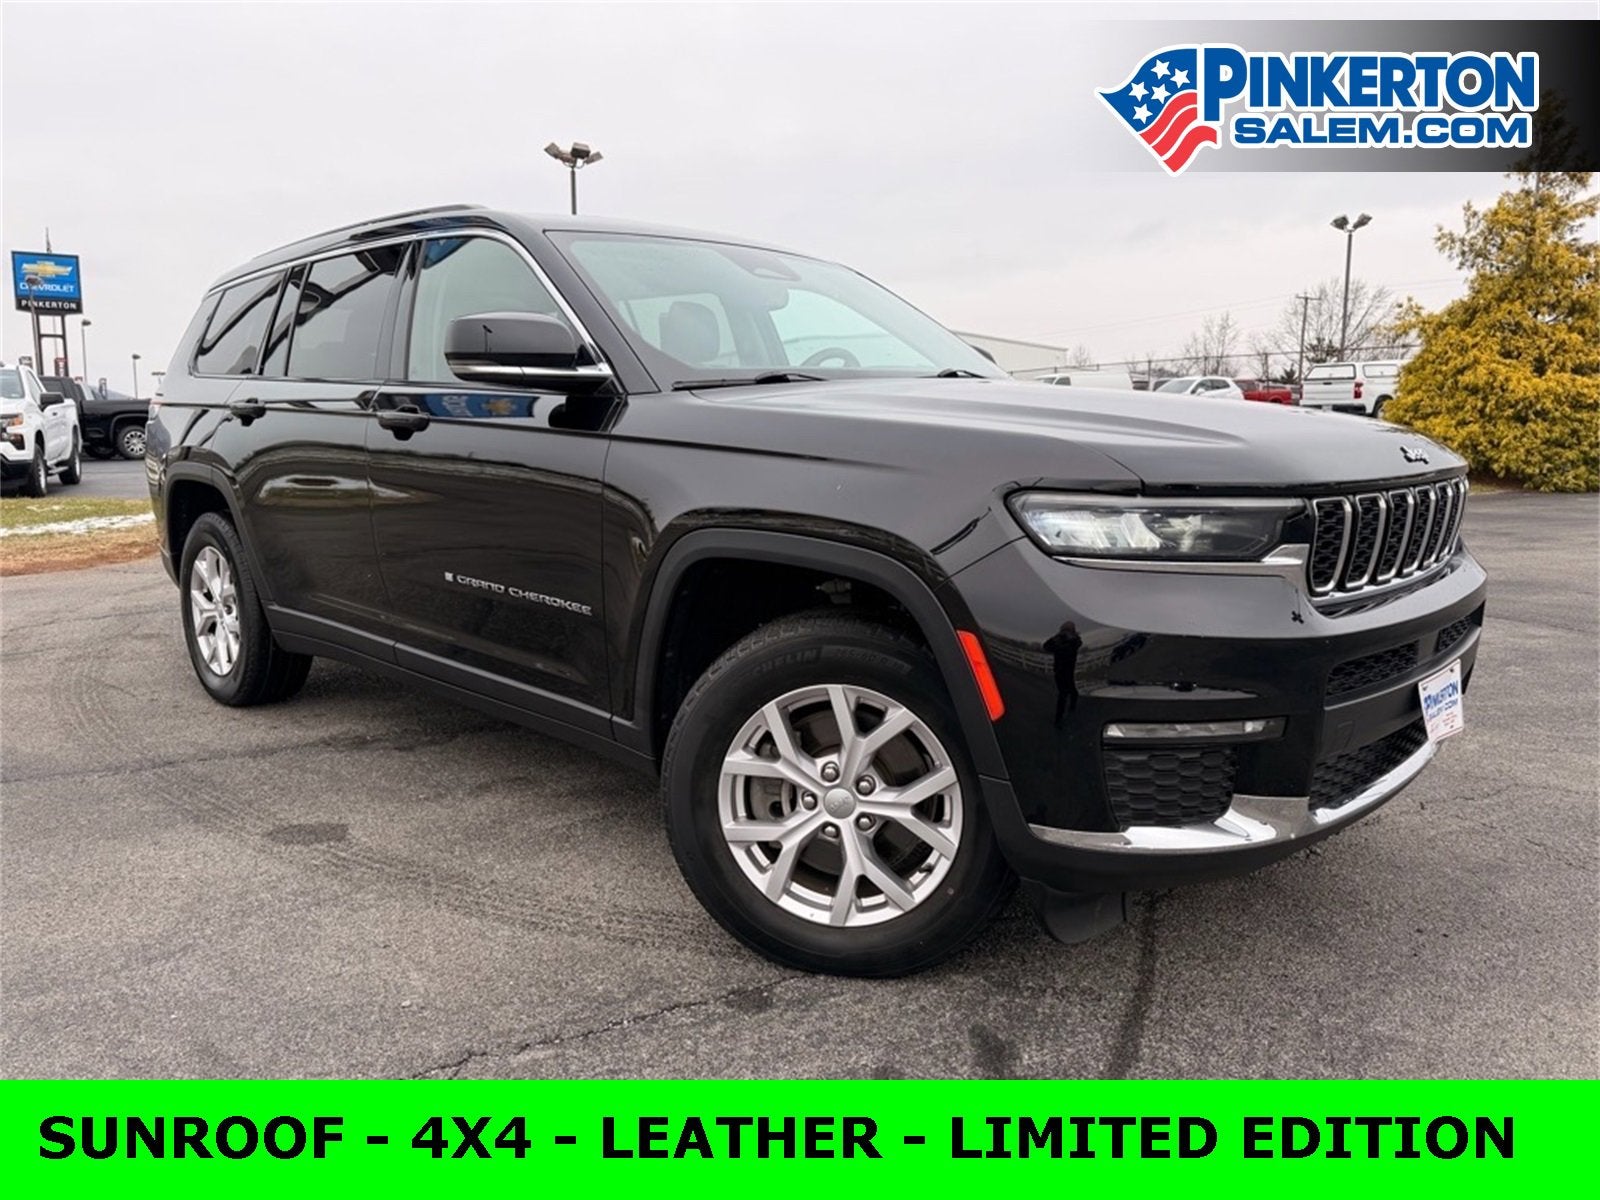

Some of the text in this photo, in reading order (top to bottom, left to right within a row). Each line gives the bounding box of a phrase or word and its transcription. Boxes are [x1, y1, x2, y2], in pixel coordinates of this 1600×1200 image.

[20, 282, 74, 292] CVROLET
[21, 299, 77, 309] PINKERTON
[456, 574, 593, 617] GRAND CHEROKEE
